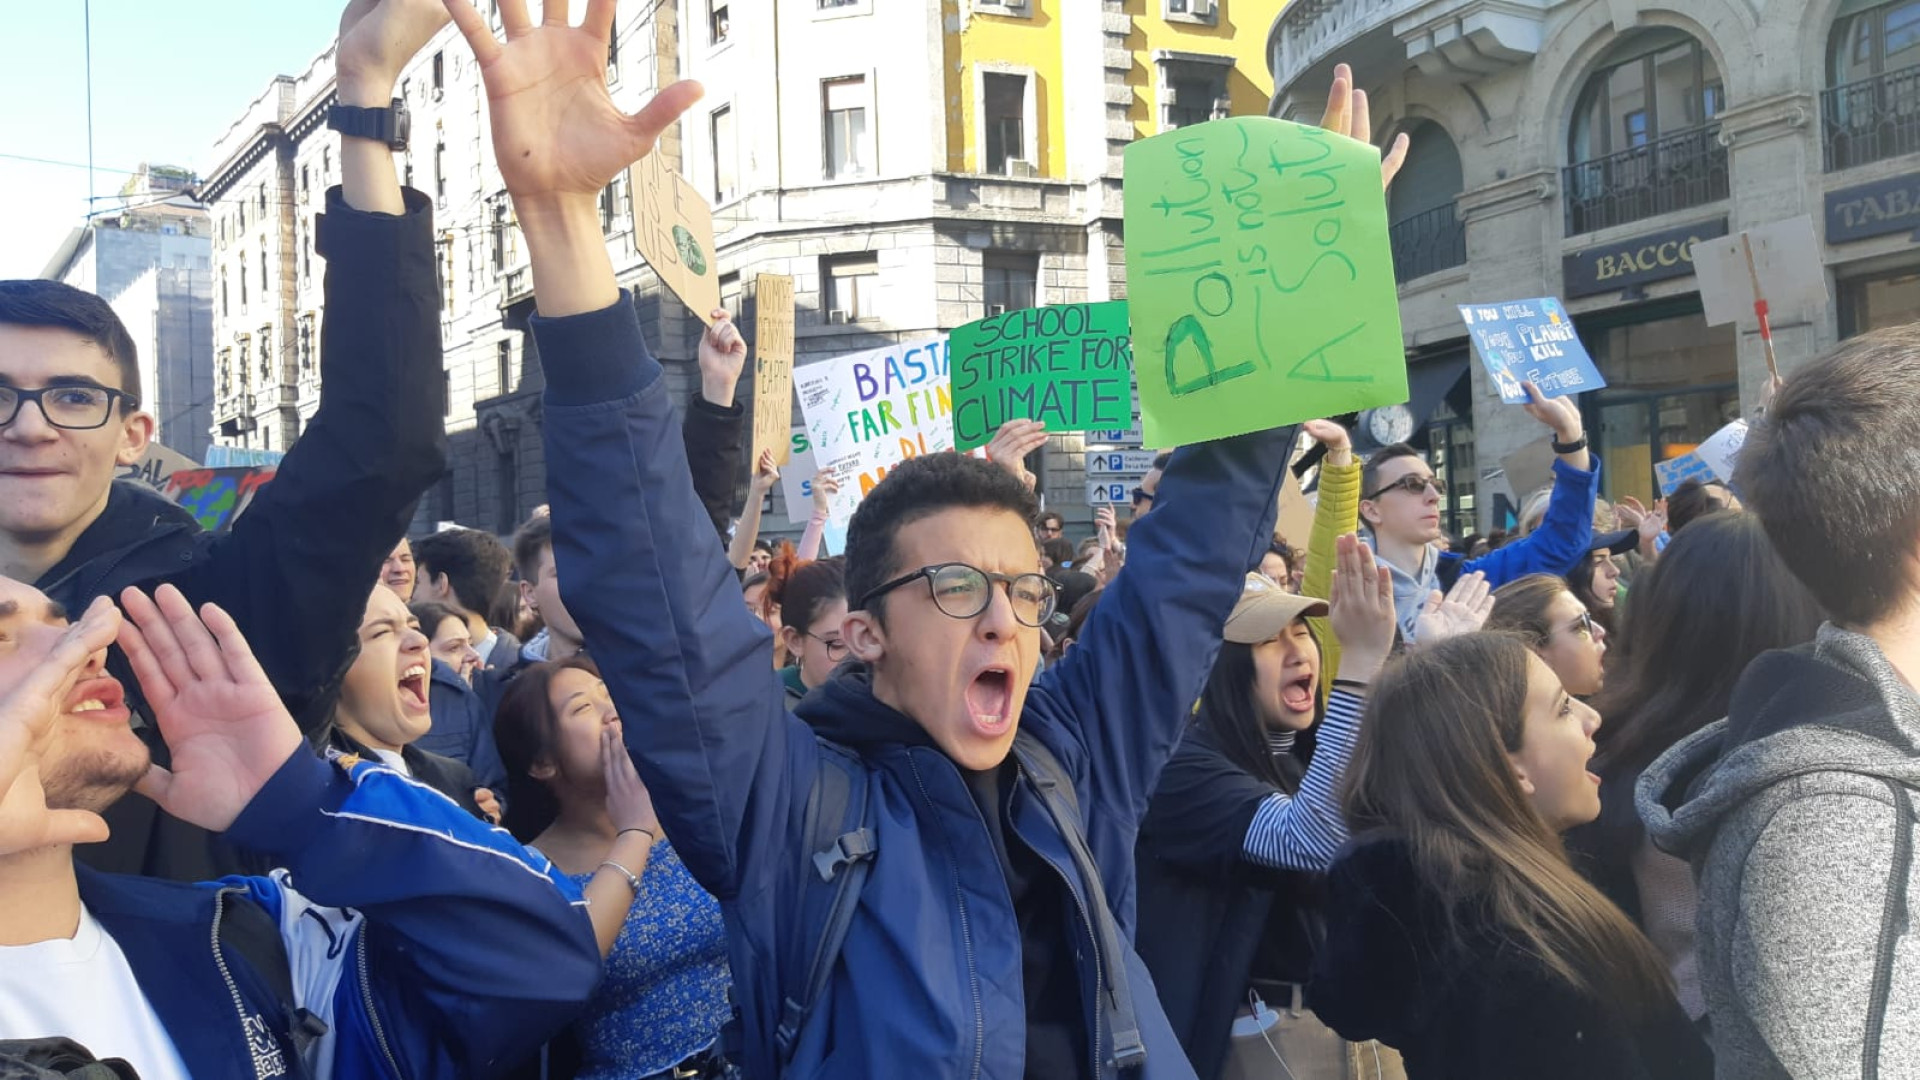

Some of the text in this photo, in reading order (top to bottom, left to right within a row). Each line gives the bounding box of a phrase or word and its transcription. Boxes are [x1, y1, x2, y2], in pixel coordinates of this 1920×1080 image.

[1221, 167, 1267, 275] is not
[1834, 187, 1920, 228] TAB
[641, 210, 678, 270] UP
[1140, 138, 1257, 396] Pollution
[973, 305, 1107, 348] SCHOOL
[1477, 308, 1499, 321] YOU
[957, 335, 1132, 391] STRIKE FOR
[1286, 322, 1375, 383] A
[1530, 342, 1564, 362] KILL
[847, 400, 903, 444] FAR
[906, 383, 953, 426] FIN
[956, 378, 1120, 442] CLIMATE
[899, 432, 928, 461] DI
